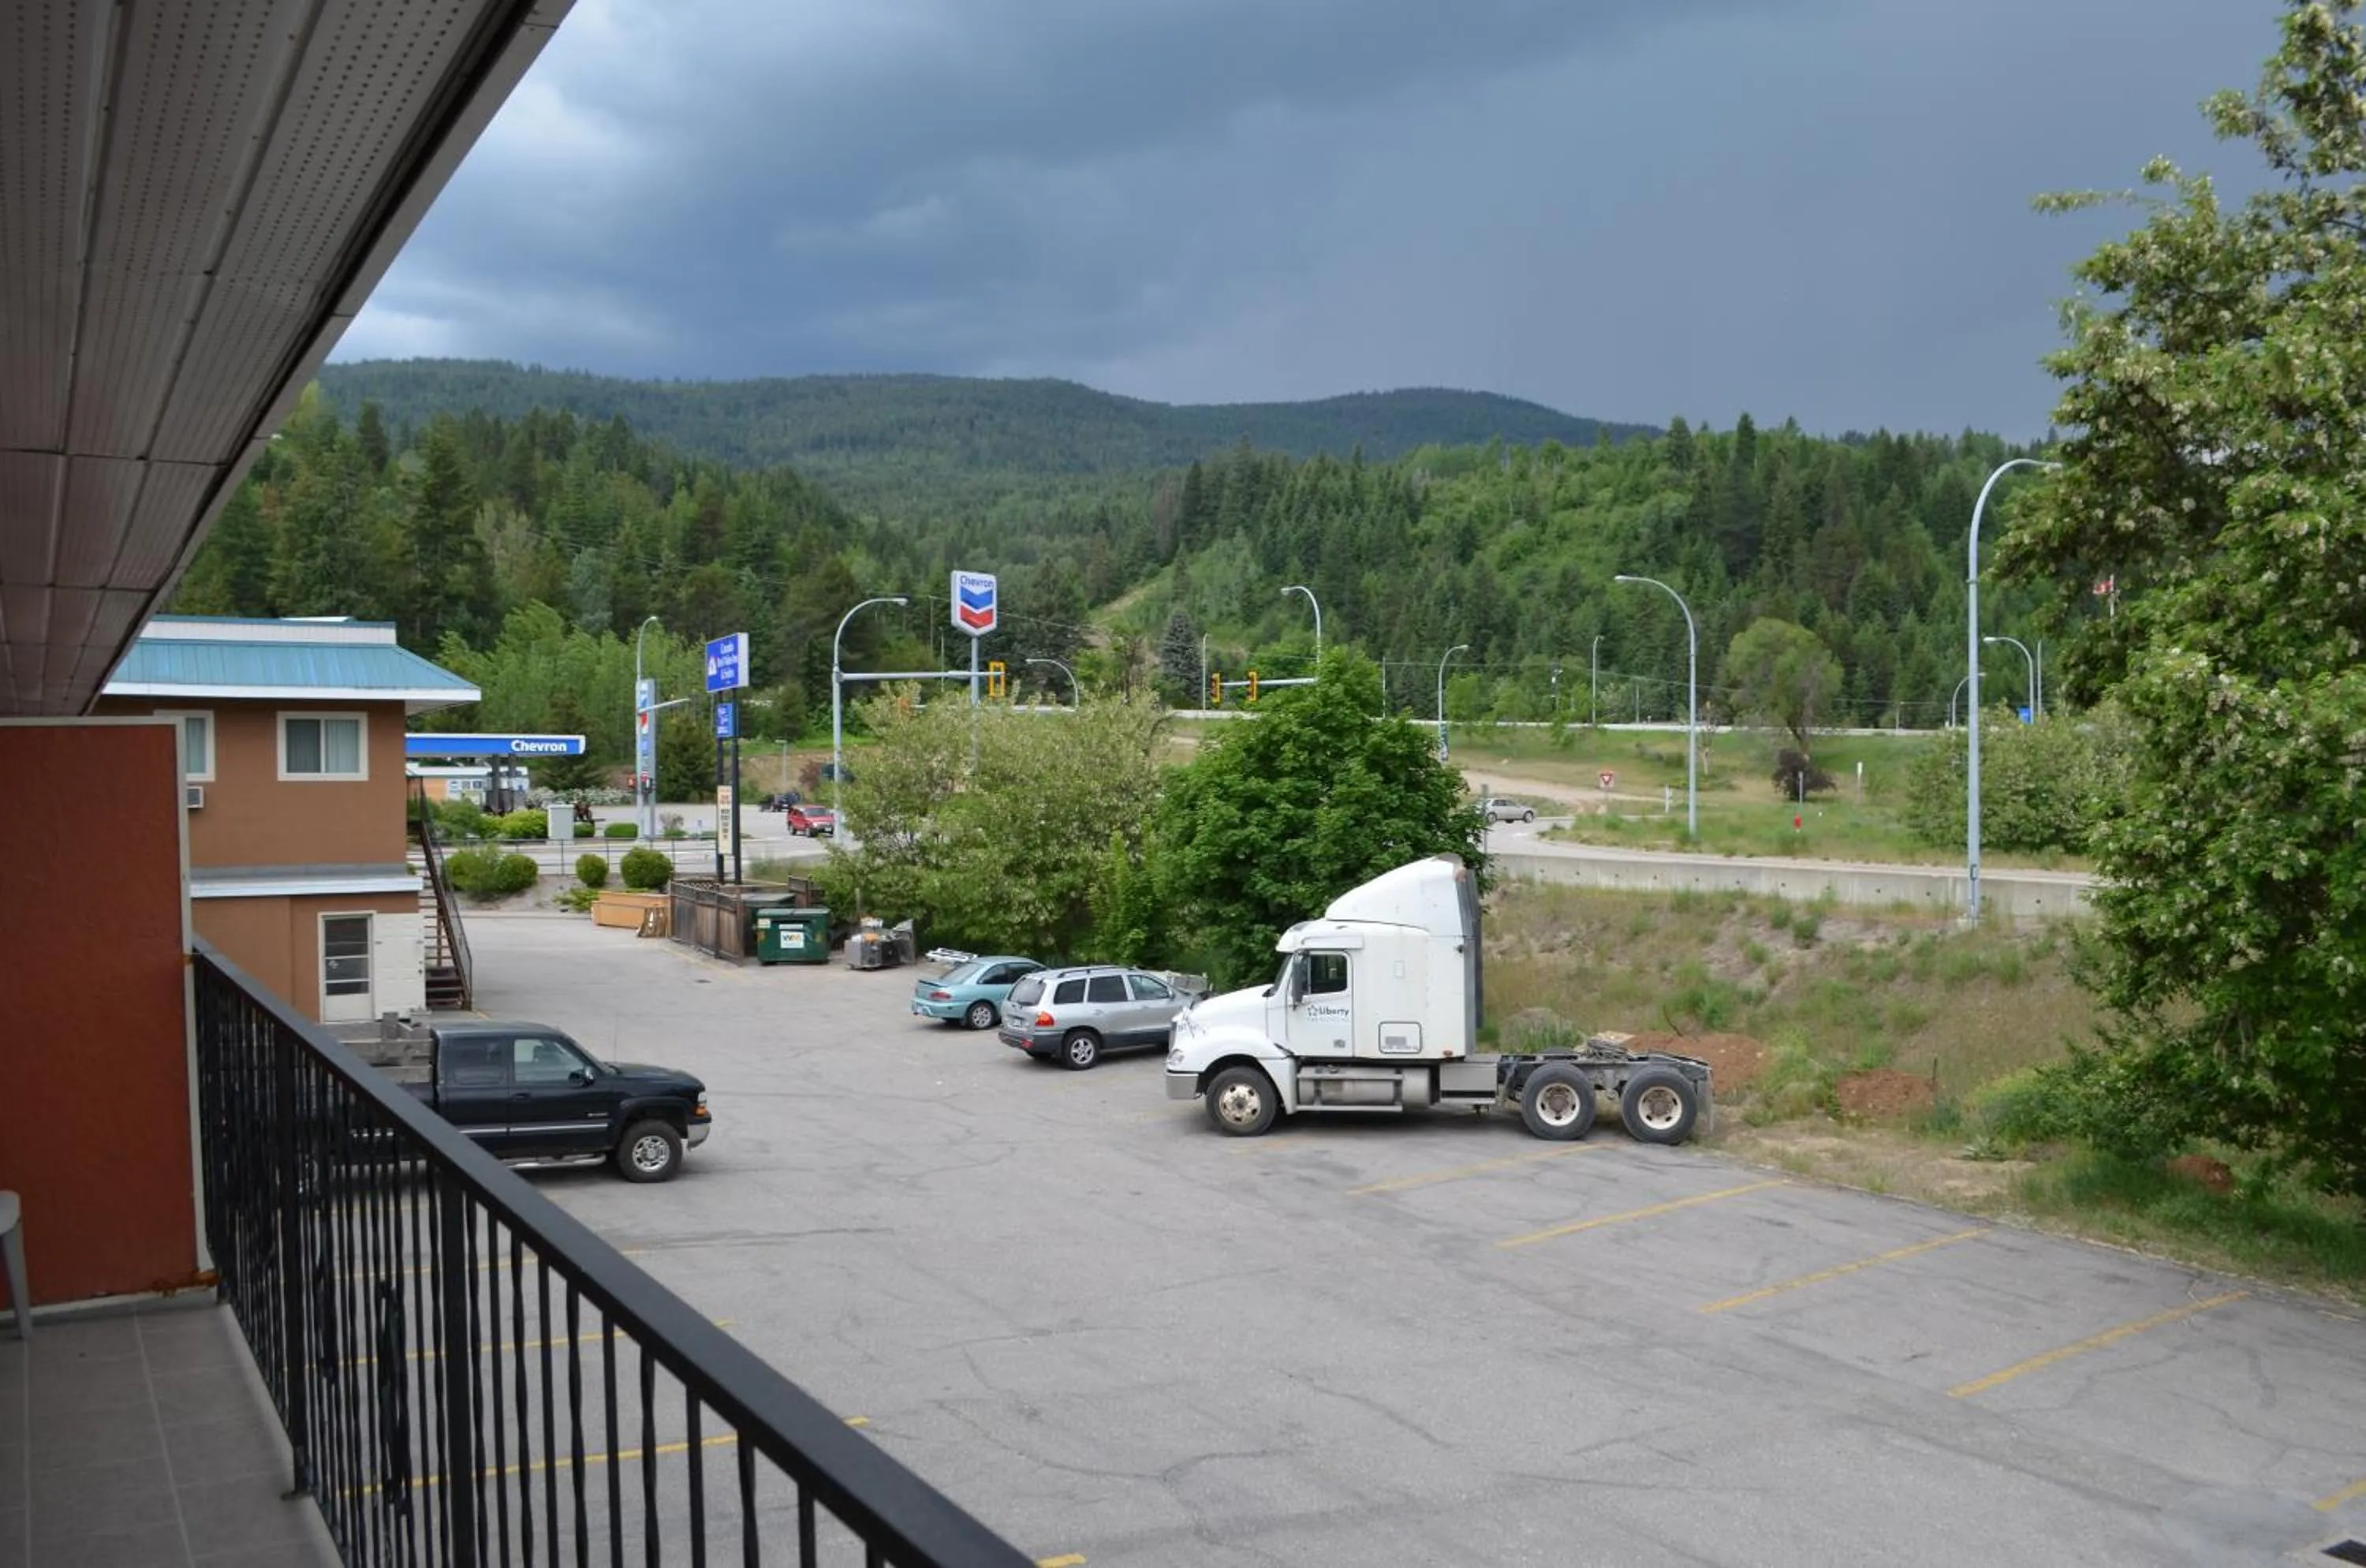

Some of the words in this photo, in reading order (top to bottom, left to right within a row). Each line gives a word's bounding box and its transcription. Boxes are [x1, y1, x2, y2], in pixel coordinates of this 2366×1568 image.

[961, 576, 994, 588] Chevron
[511, 740, 567, 752] Chevron
[1319, 1006, 1349, 1016] Liberty
